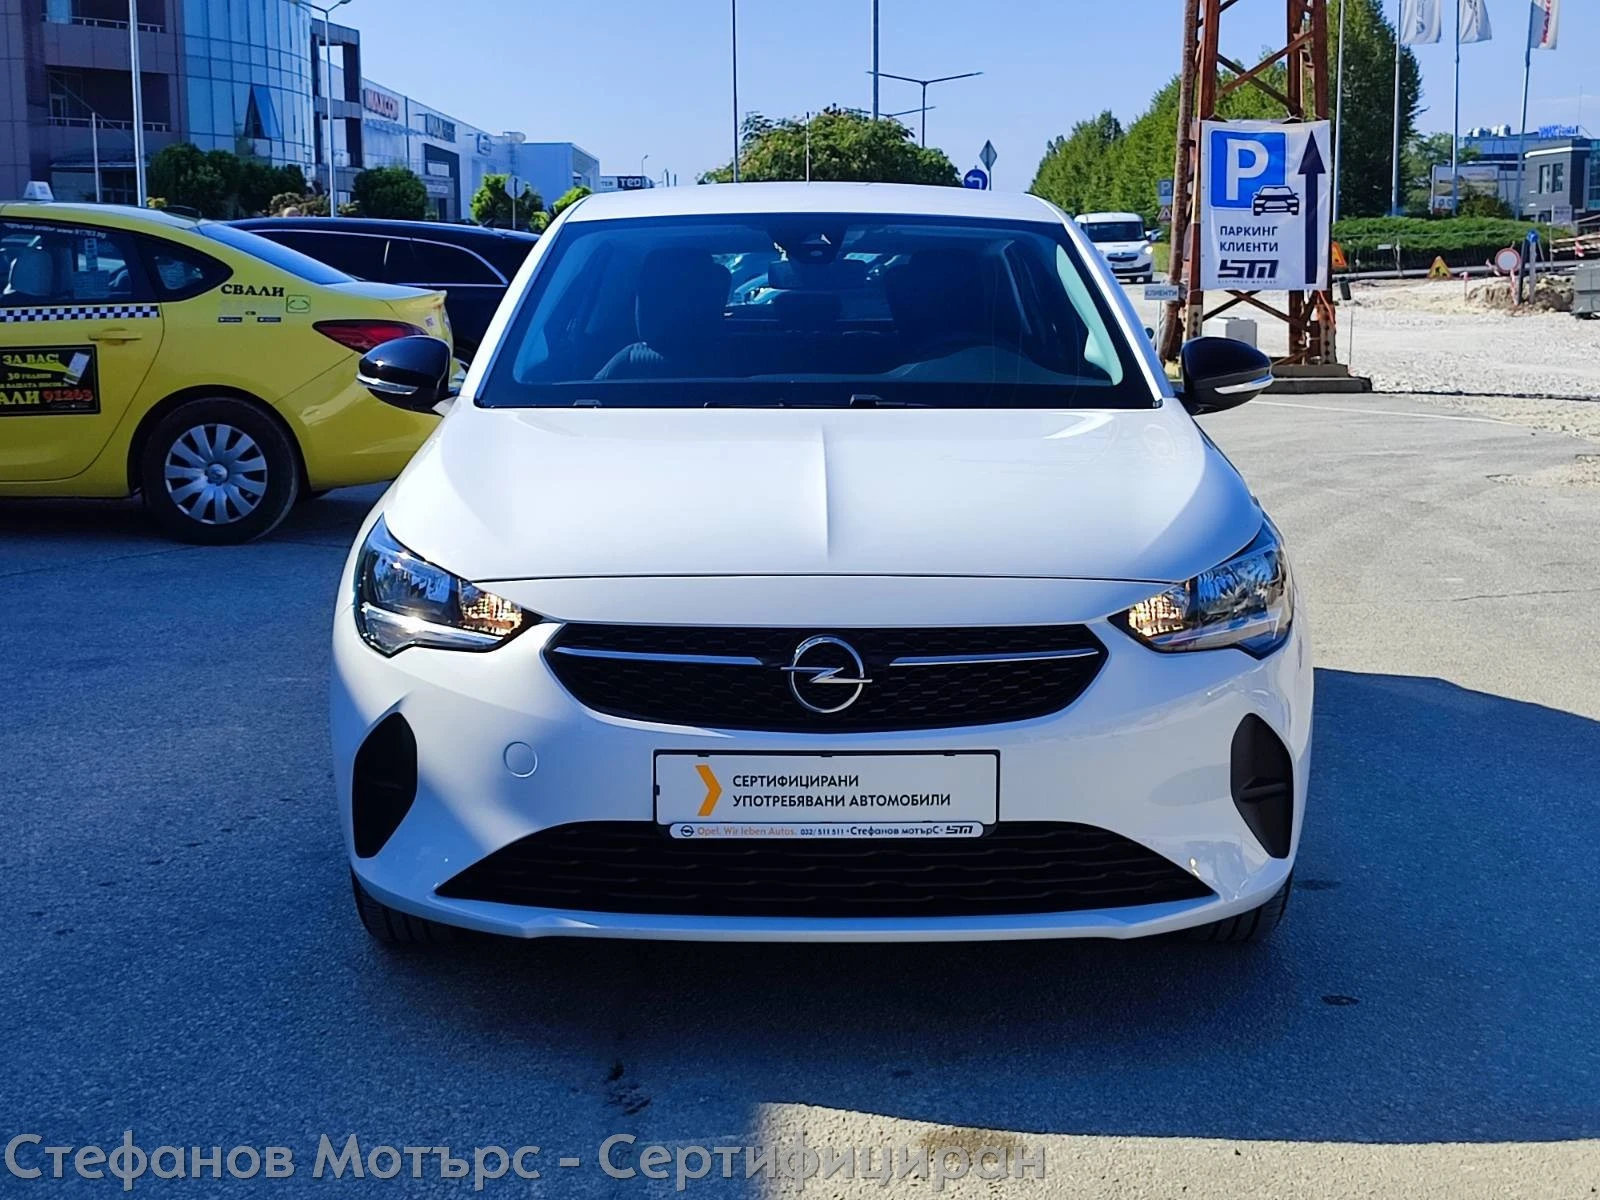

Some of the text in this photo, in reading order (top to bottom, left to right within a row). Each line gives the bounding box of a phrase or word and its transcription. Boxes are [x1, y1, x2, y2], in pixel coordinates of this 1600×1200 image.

[1226, 138, 1269, 201] P
[1161, 182, 1172, 195] P
[1220, 226, 1278, 237] ПАРКИНГ
[1220, 241, 1278, 252] КЛИЕНТИ
[221, 283, 285, 297] СВАЛИ
[2, 353, 59, 364] ЗА ВАС!
[8, 373, 19, 381] 30
[732, 775, 860, 789] СЕРТИФИЦИРАНИ
[732, 794, 951, 807] УПОТРЕБЯВАНИ АВТОМОБИЛИ
[724, 827, 739, 836] Wir
[741, 827, 768, 836] leben
[769, 827, 797, 836] Autos.
